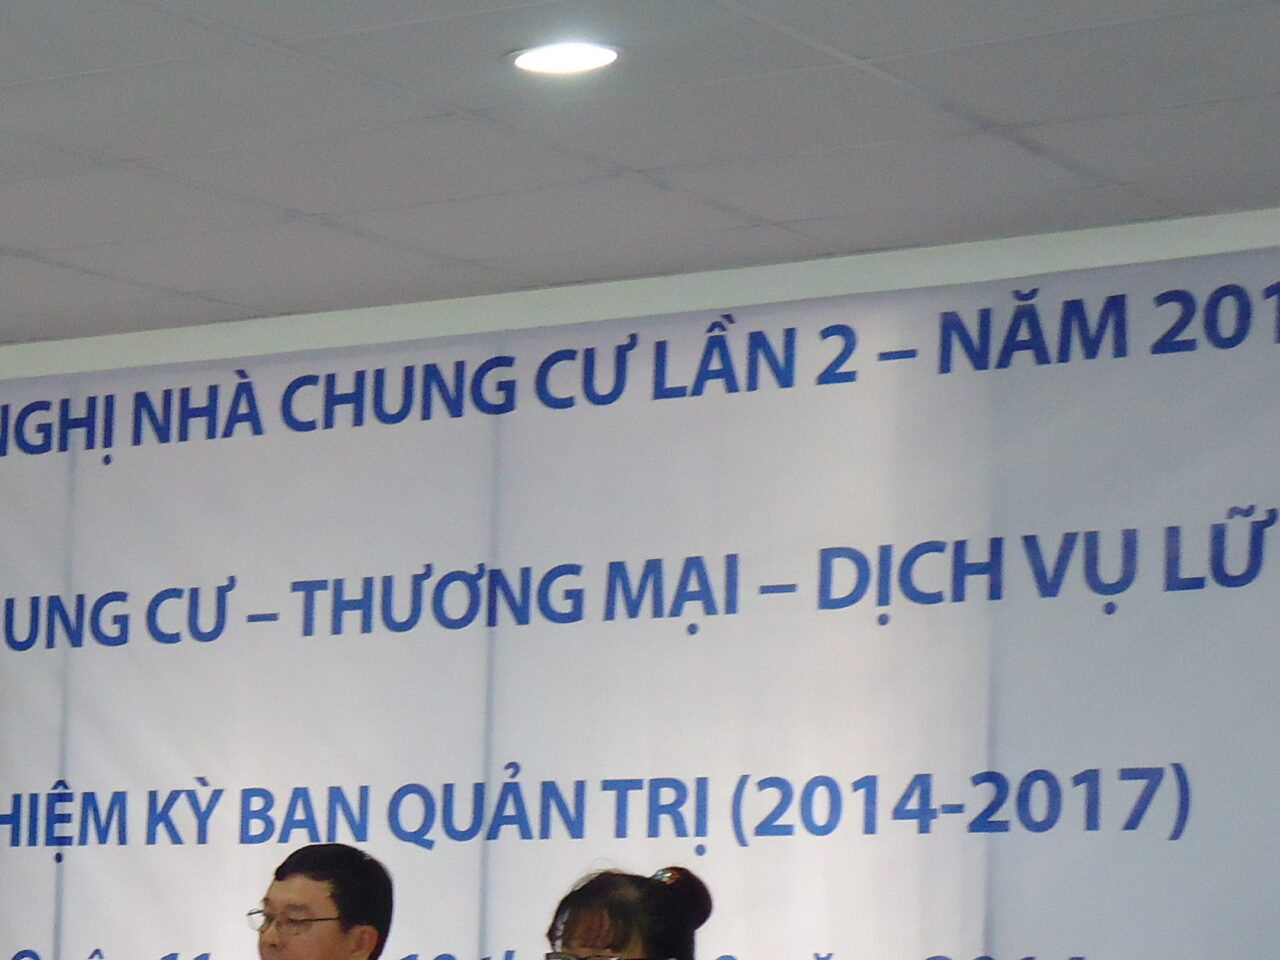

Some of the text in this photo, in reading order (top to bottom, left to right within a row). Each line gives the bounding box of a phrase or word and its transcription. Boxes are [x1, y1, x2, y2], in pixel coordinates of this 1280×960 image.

[131, 369, 265, 447] NHÀ
[280, 355, 519, 434] CHUNG
[534, 333, 639, 411] CƯ
[651, 313, 798, 402] LẦN
[815, 324, 859, 386] 2
[937, 288, 1129, 376] NĂM
[1150, 281, 1280, 356] 201
[145, 576, 238, 646] CƯ
[291, 562, 587, 638] THƯƠNG
[602, 553, 740, 636] MẠI
[817, 536, 1007, 627] DỊCH
[1021, 528, 1141, 616] VỤ
[1163, 504, 1280, 593] LỮ
[145, 776, 226, 847] KỲ
[237, 784, 372, 846] BAN
[385, 761, 588, 853] QUẢN
[599, 776, 710, 857] TRỊ
[730, 762, 1194, 848] (2014-2017)
